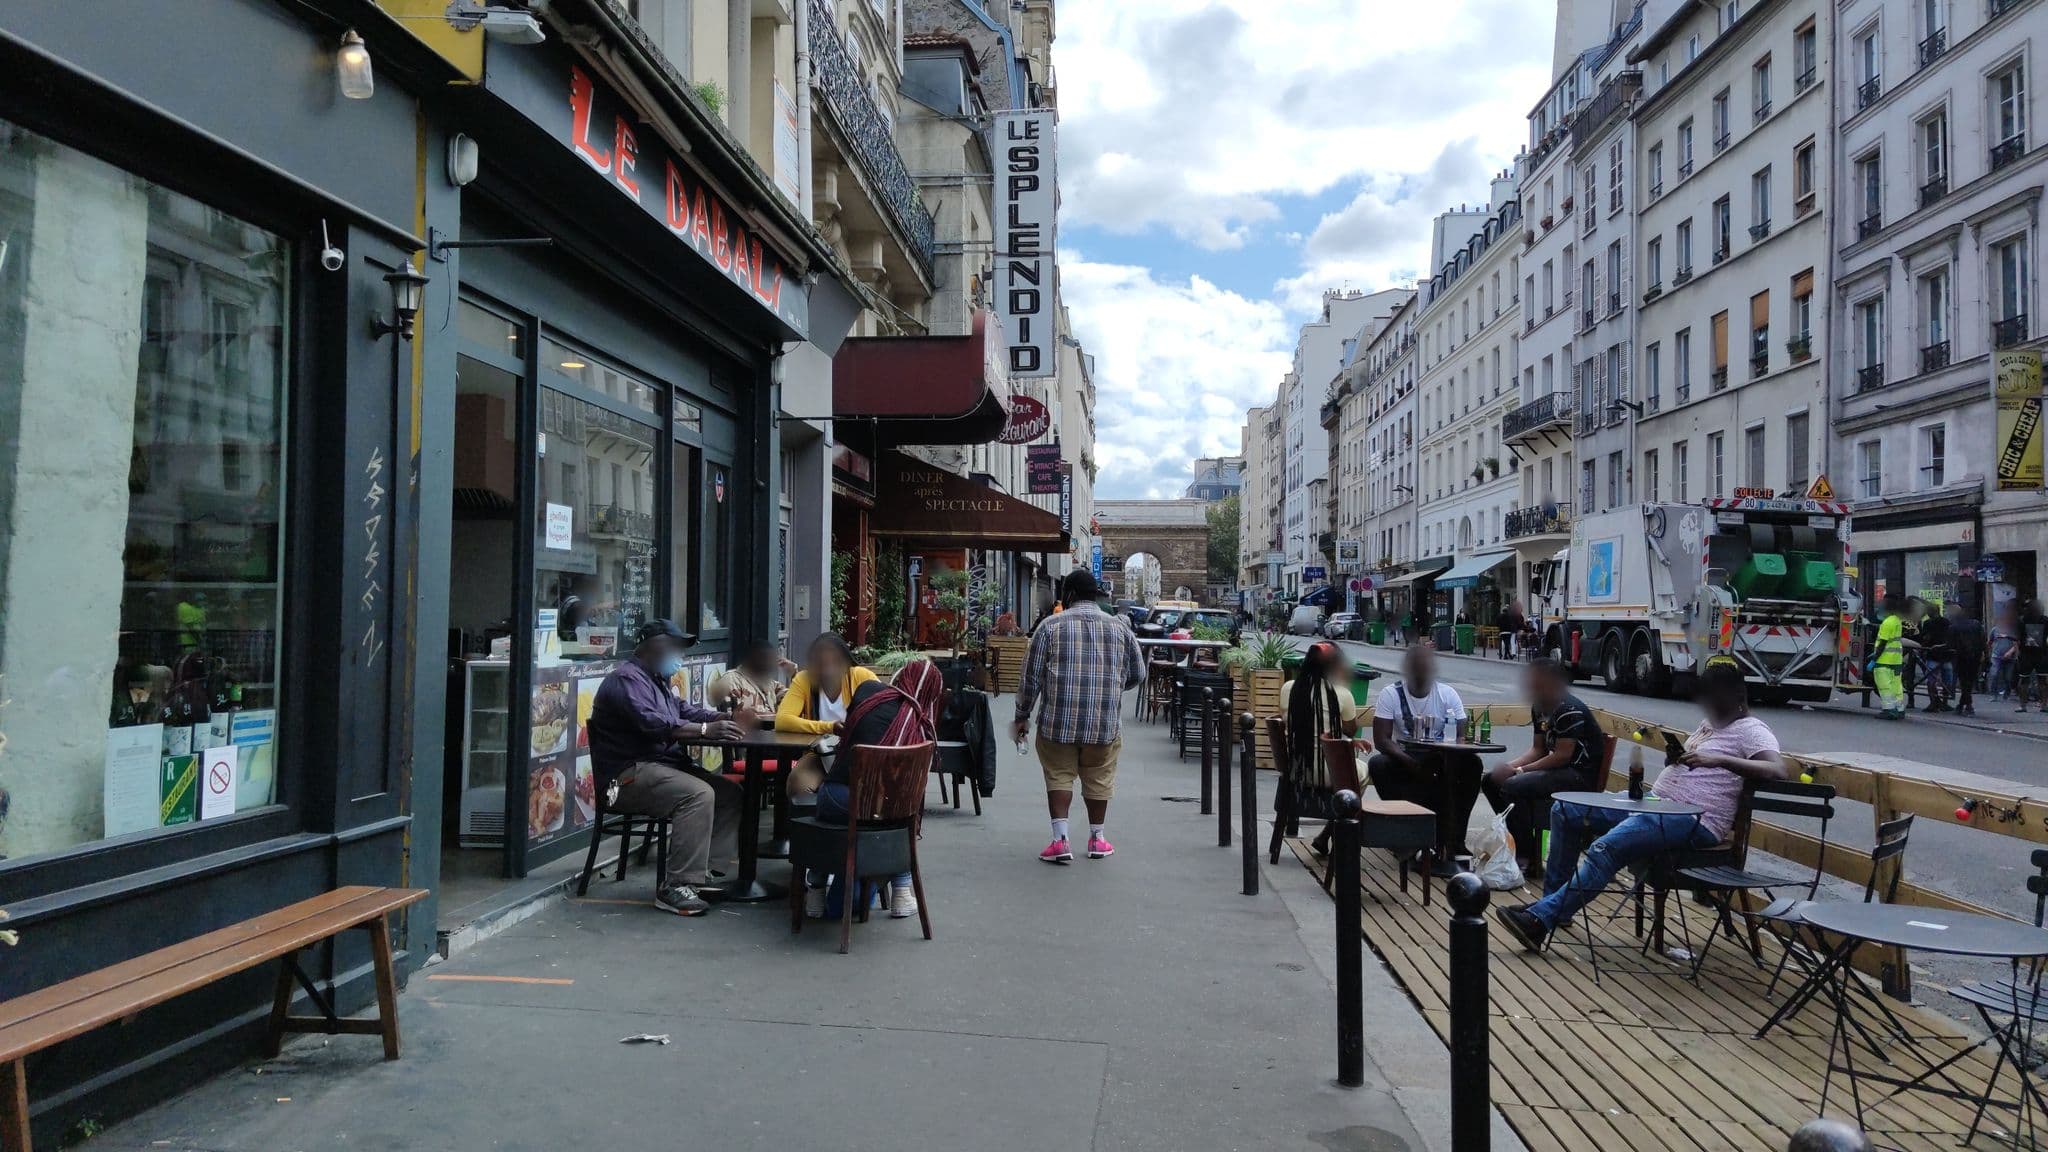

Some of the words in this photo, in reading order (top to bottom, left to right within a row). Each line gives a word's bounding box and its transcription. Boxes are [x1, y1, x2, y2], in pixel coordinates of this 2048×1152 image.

[570, 64, 641, 204] LE
[1008, 119, 1040, 141] LE
[1008, 146, 1040, 372] SPLENDID
[1999, 446, 2021, 478] CHIC
[2014, 399, 2041, 440] CHEAP
[925, 499, 1005, 512] SPECTACLE
[1744, 498, 1755, 508] 80
[1805, 501, 1816, 511] 90
[1961, 529, 1972, 541] 41
[167, 761, 175, 781] R
